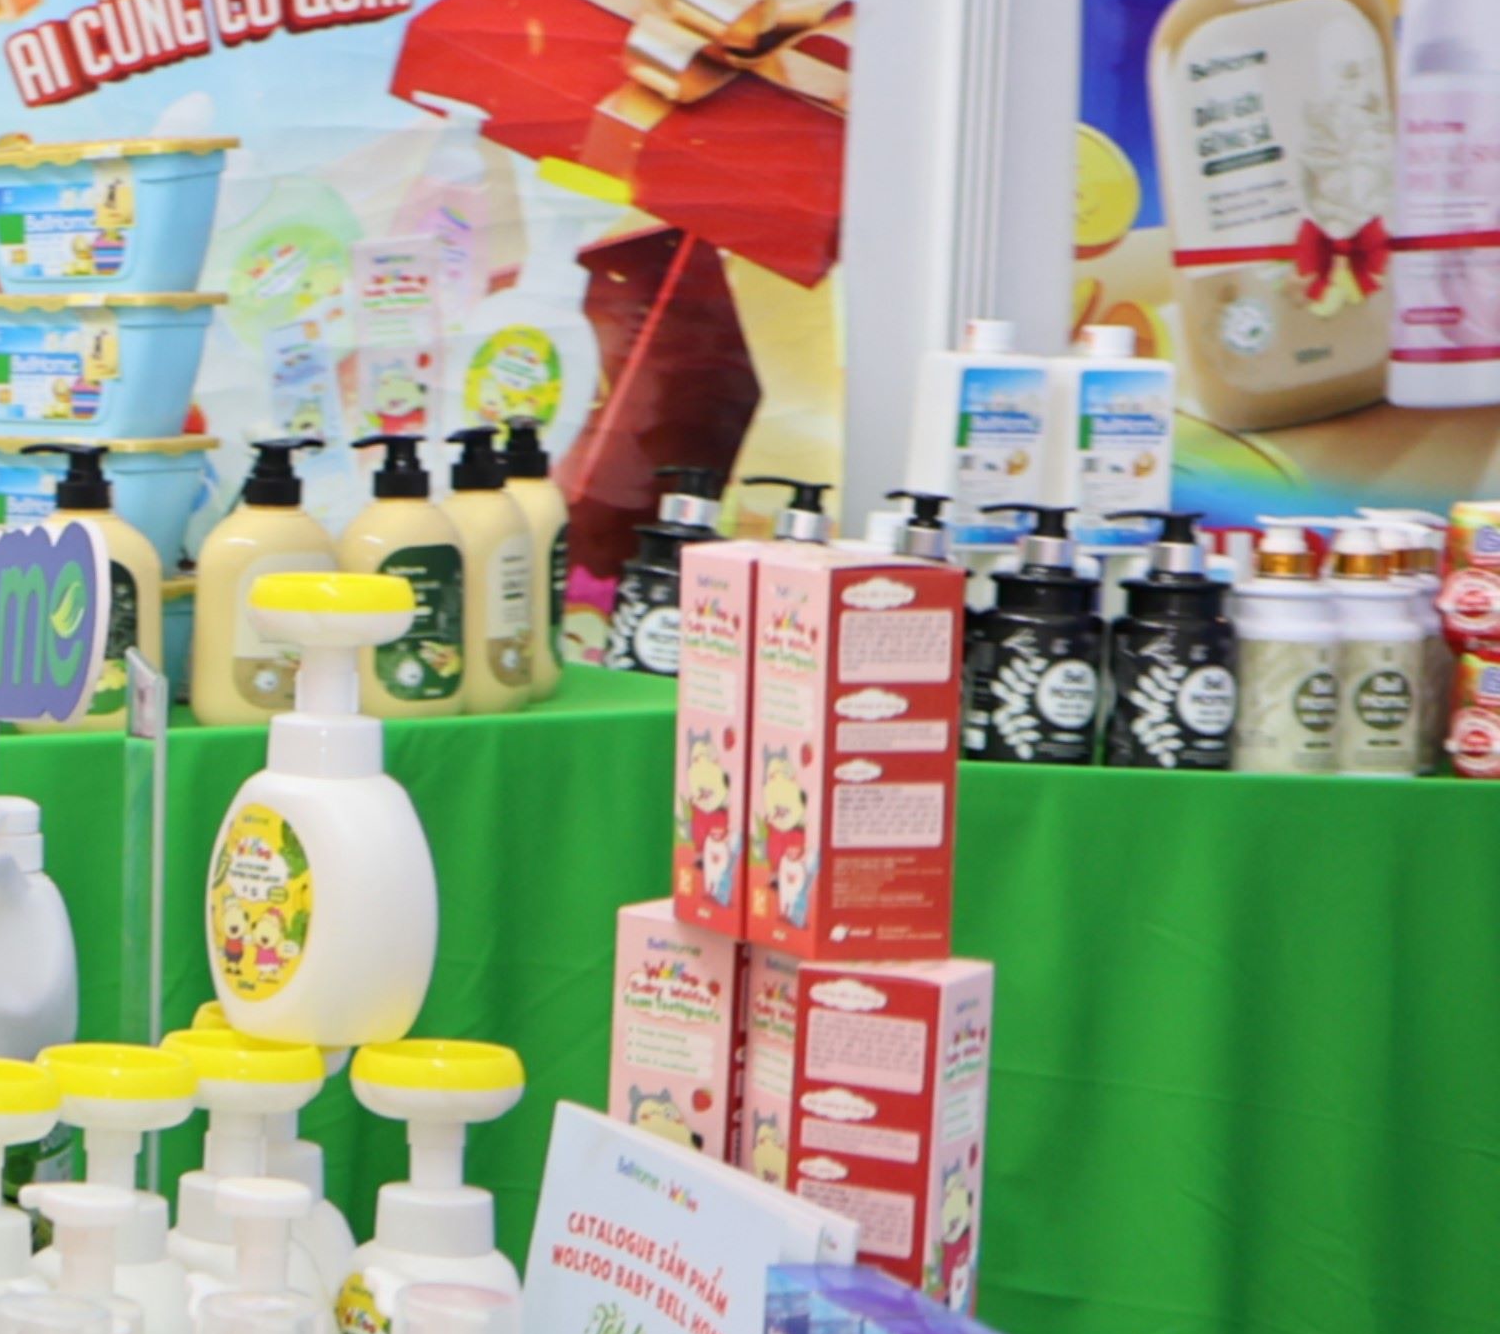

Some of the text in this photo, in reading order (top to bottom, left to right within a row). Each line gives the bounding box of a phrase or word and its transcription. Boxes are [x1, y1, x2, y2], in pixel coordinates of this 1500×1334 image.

[3, 17, 74, 107] AI
[567, 1211, 657, 1264] CATALOGUE
[551, 1243, 613, 1283] WOLFOO
[614, 1264, 656, 1301] BABY
[656, 1286, 689, 1329] BELL
